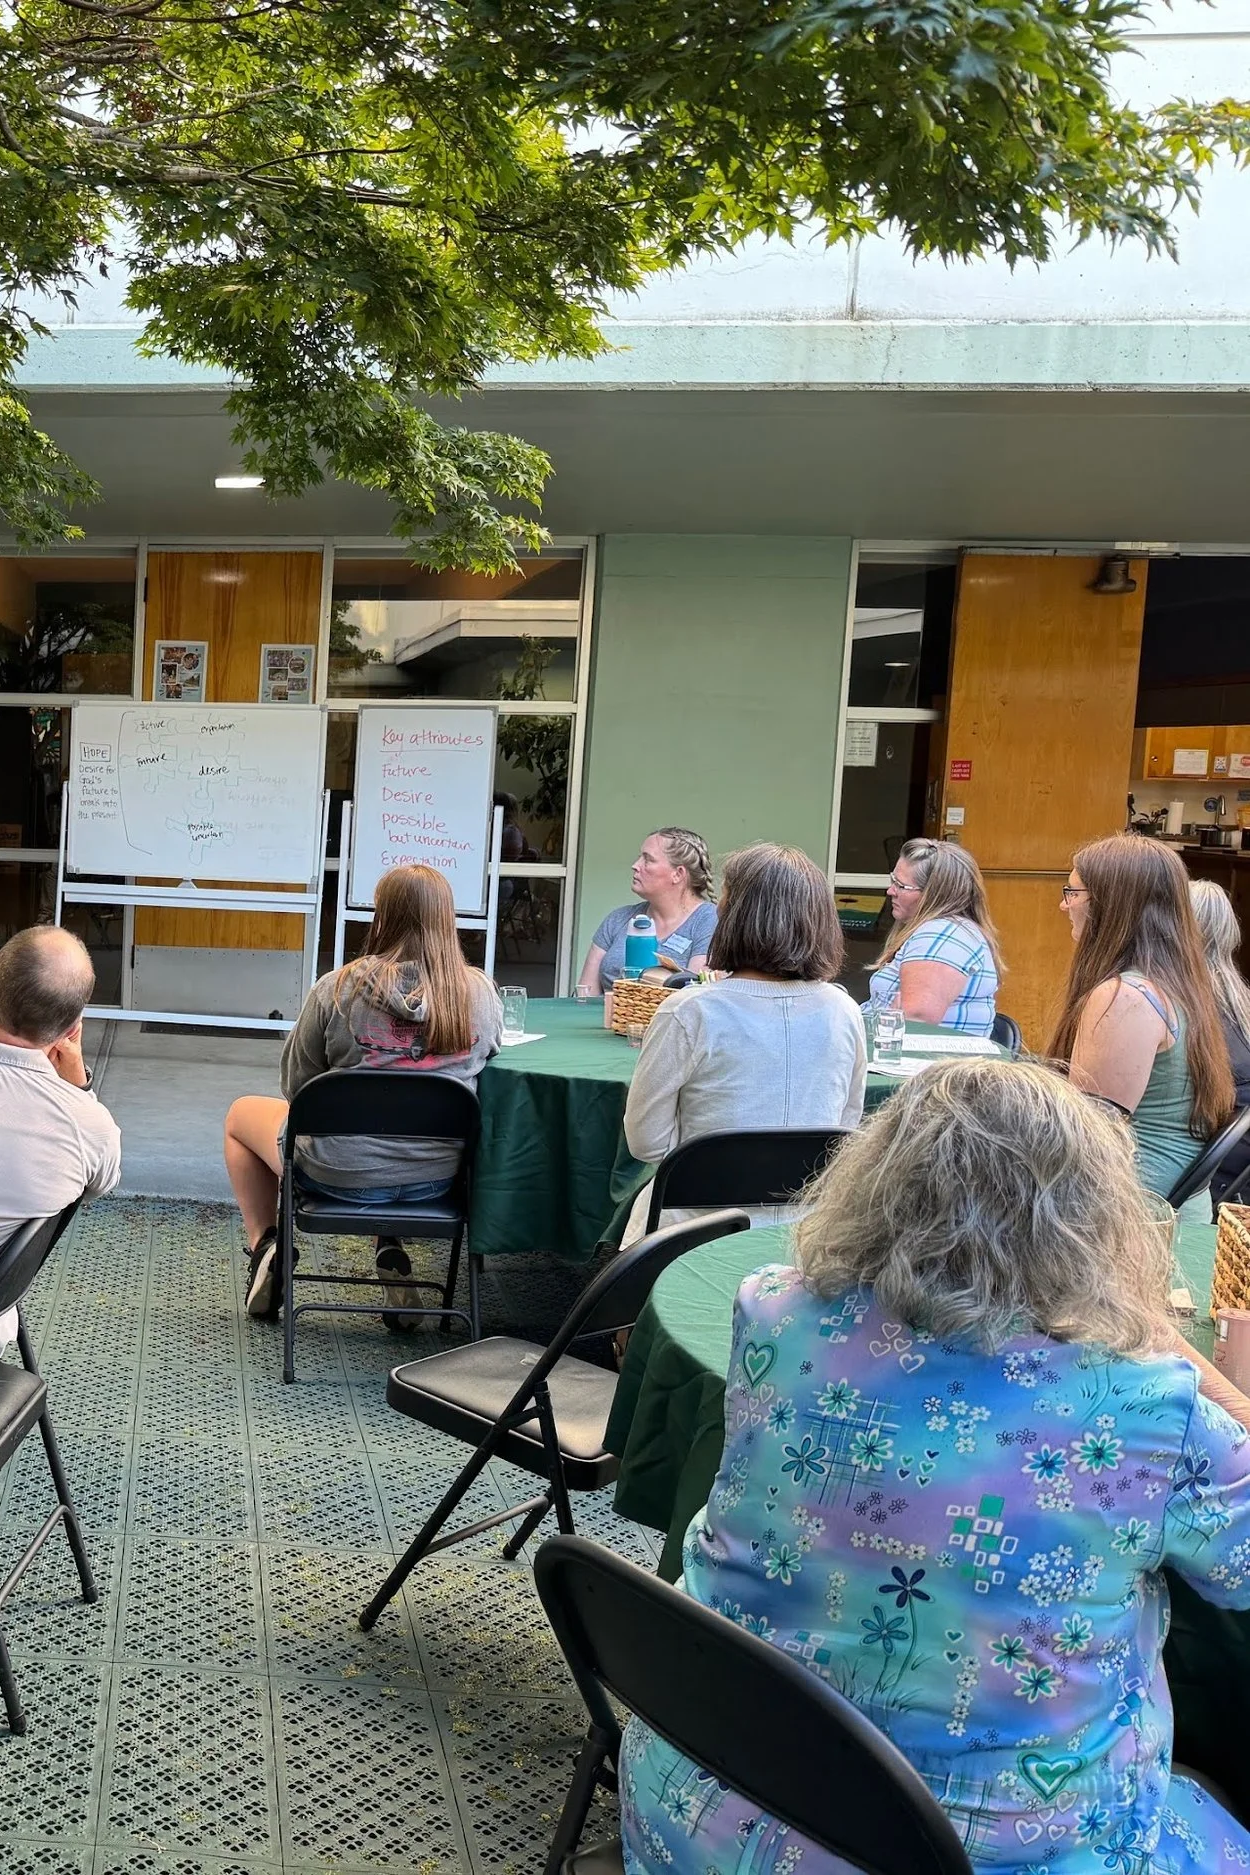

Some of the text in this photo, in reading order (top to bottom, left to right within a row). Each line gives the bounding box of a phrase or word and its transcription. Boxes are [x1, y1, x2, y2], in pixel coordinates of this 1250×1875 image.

[382, 725, 483, 750] Key attributes
[83, 746, 108, 759] HOPE
[79, 764, 116, 775] Desire for
[382, 763, 432, 779] Future
[110, 787, 118, 795] to
[382, 787, 434, 805] Desire
[382, 812, 449, 834] possible
[388, 830, 412, 843] but
